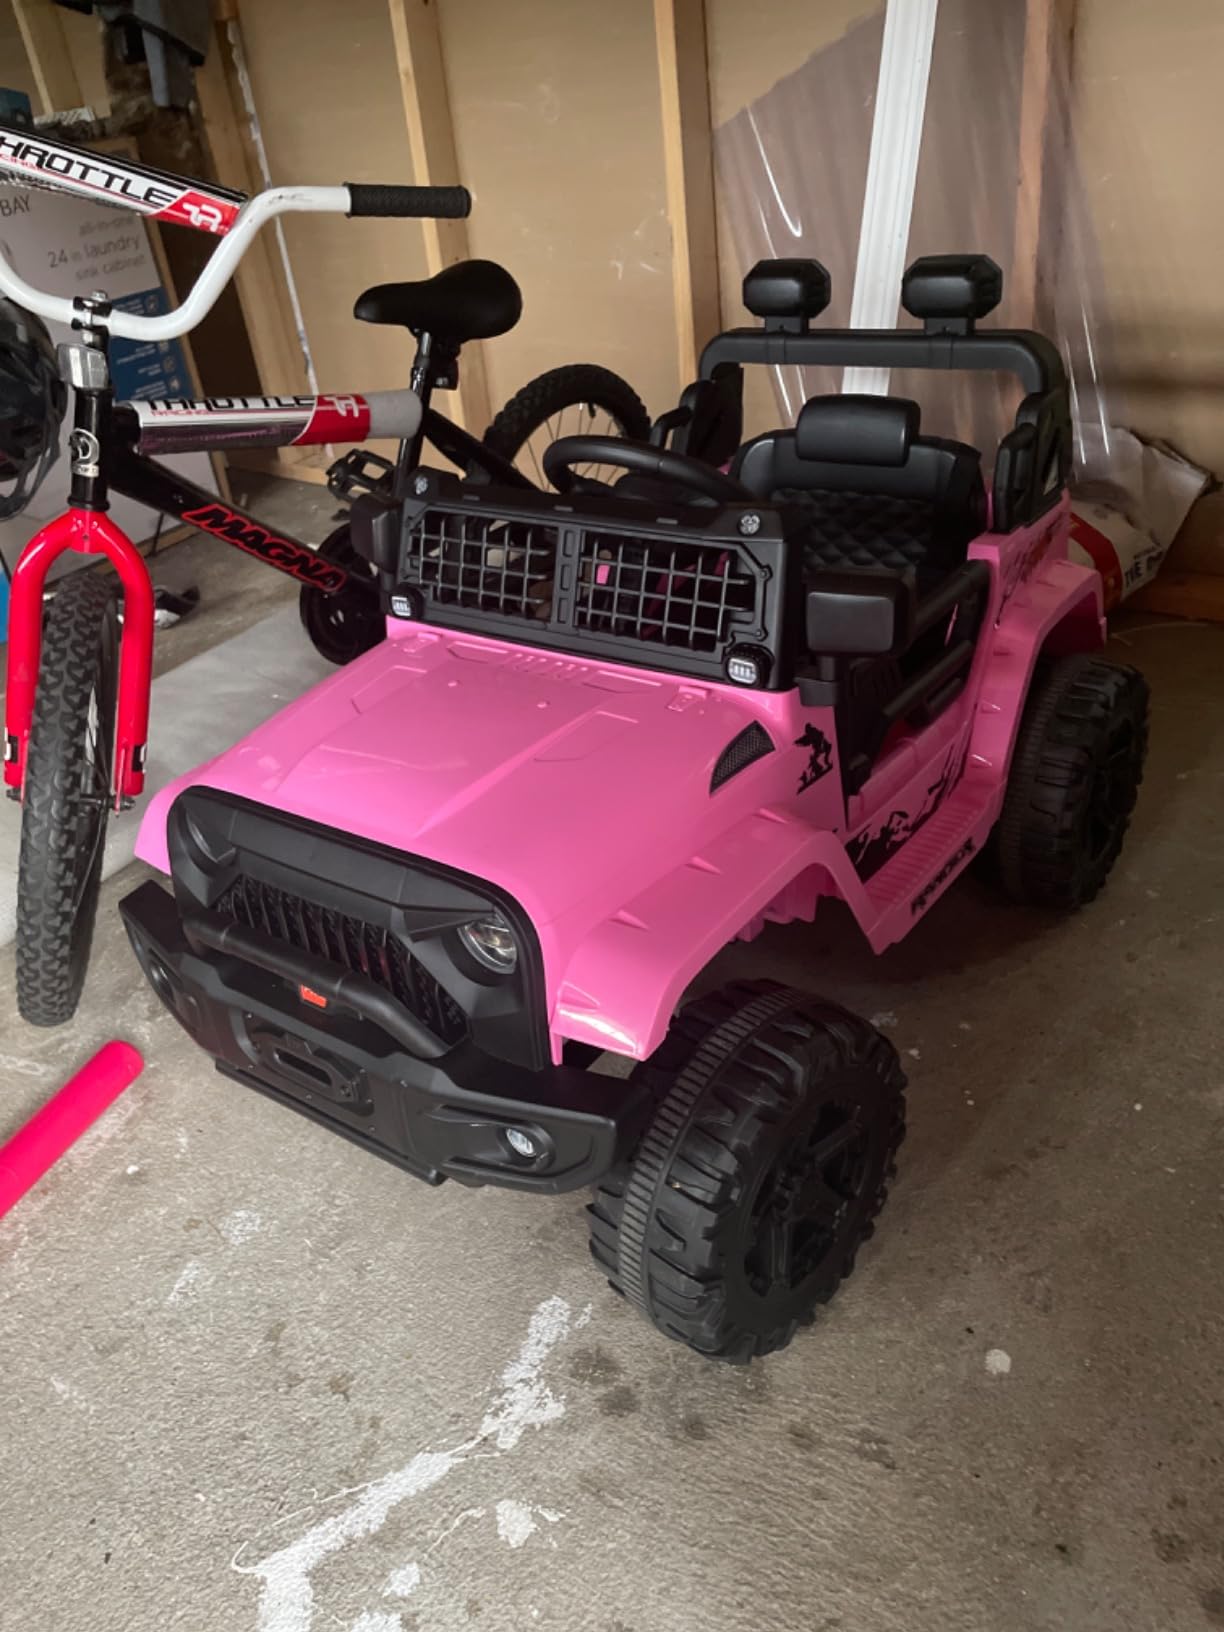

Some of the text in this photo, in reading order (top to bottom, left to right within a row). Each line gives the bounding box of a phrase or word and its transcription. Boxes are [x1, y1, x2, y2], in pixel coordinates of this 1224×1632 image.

[47, 247, 69, 268] 24
[83, 235, 140, 258] laundry
[182, 502, 347, 592] MAGNA
